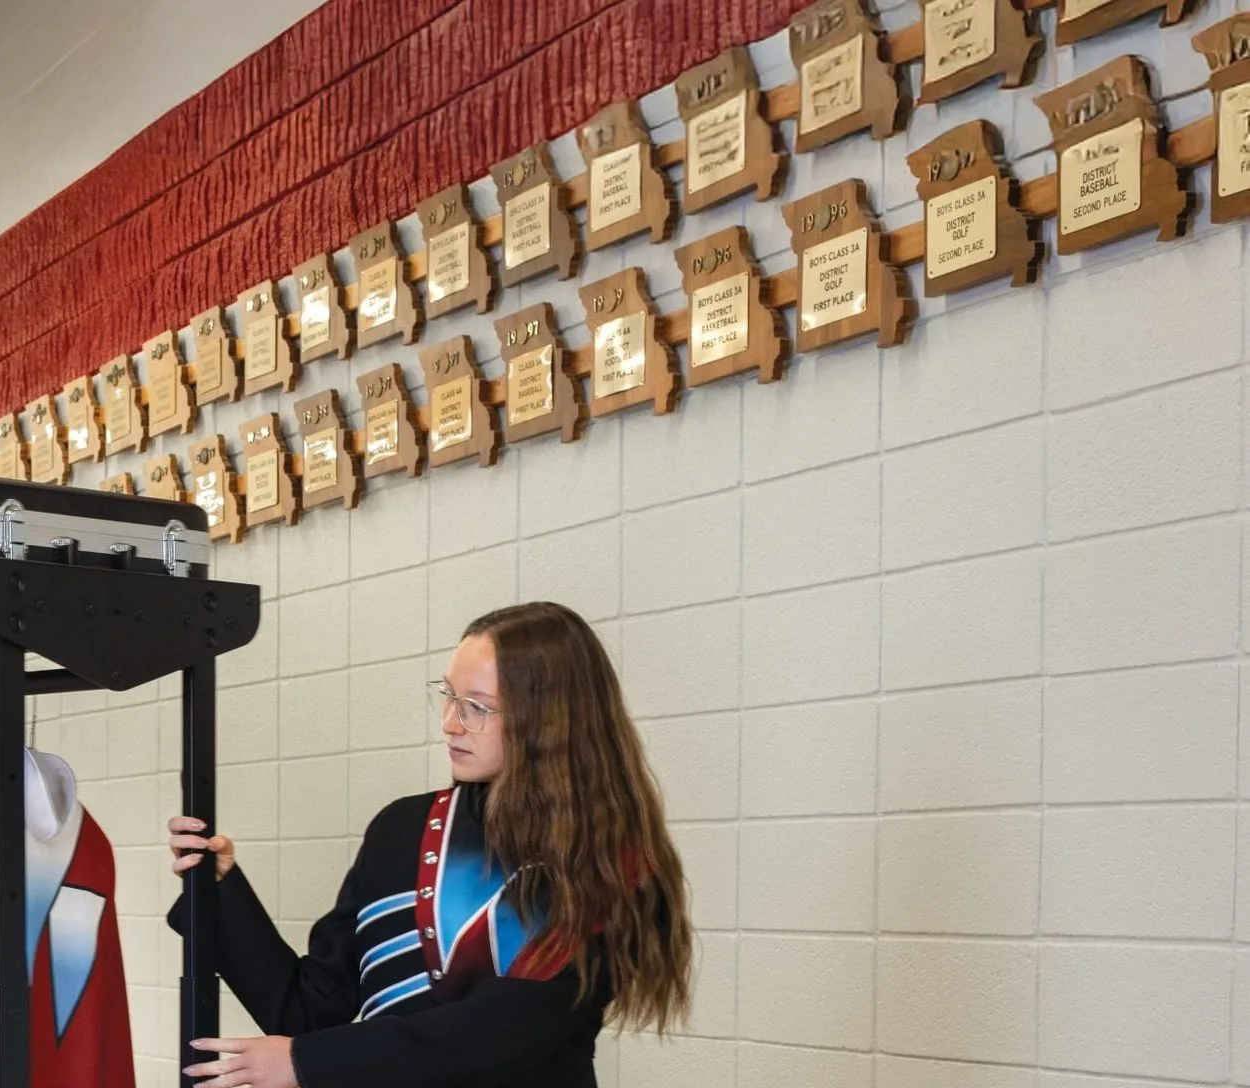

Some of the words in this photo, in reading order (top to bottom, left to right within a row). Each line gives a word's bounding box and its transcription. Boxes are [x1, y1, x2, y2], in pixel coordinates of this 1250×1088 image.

[604, 170, 627, 189] DISTRICT
[1083, 158, 1119, 184] DISTRICT
[602, 184, 628, 200] BASEBALL
[1080, 175, 1119, 197] BASEBALL
[599, 202, 613, 216] FIRST
[614, 195, 631, 209] PLACE
[937, 202, 953, 217] BOYS
[955, 194, 975, 210] CLASS
[977, 190, 986, 202] 3A
[1073, 200, 1101, 219] SECOND
[1103, 190, 1127, 208] PLACE
[515, 211, 537, 228] DISTRICT
[946, 212, 975, 232] DISTRICT
[511, 223, 541, 240] BASKETBALL
[952, 226, 970, 241] GOLF
[525, 235, 541, 248] PLACE
[437, 249, 458, 265] DISTRICT
[809, 254, 827, 268] BOYS
[828, 246, 849, 262] CLASS
[851, 243, 860, 254] 3A
[938, 247, 962, 264] SECOND
[964, 239, 984, 255] PLACE
[819, 264, 848, 282] DISTRICT
[824, 277, 843, 291] GOLF
[698, 295, 713, 308] BOYS
[715, 289, 733, 302] CLASS
[734, 285, 742, 296] 3A
[813, 299, 830, 312] FIRST
[832, 291, 854, 307] PLACE
[707, 305, 733, 321] DISTRICT
[701, 314, 738, 335] BASKETBALL
[606, 342, 630, 357] DISTCT
[701, 338, 717, 351] FIRST
[718, 331, 737, 344] PLACE
[518, 361, 535, 373] CLASS
[519, 373, 541, 387] DISTRICT
[603, 371, 615, 382] FIRST
[440, 391, 455, 401] CLASS
[518, 388, 542, 399] BASEBALL
[440, 402, 461, 415] DISTRICT
[516, 403, 529, 415] FIRST
[439, 413, 462, 425] FOOTBALL
